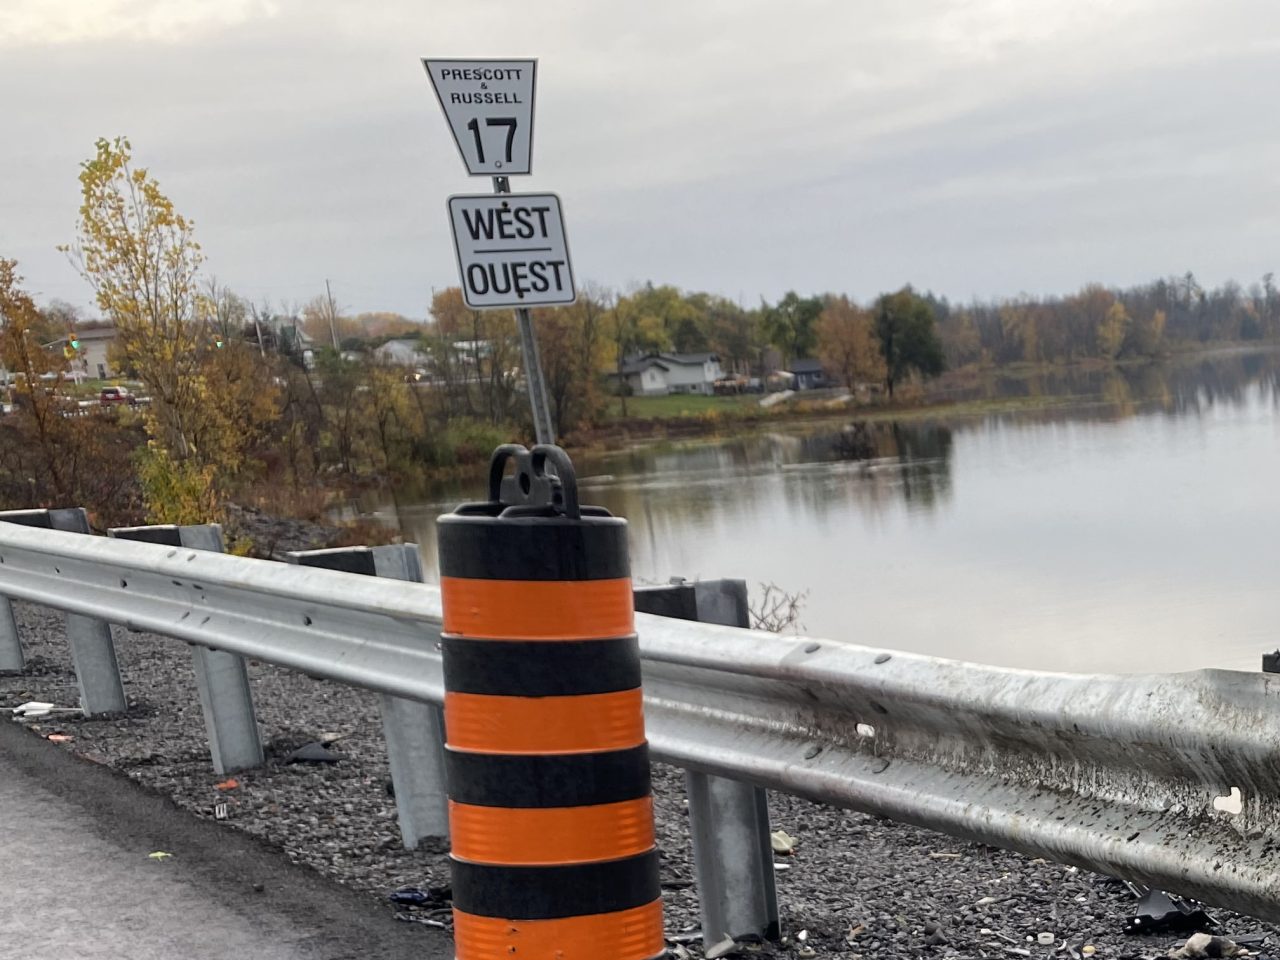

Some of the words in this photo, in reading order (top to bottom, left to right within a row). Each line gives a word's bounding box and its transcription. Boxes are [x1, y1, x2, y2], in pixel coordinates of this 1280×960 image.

[441, 68, 523, 81] PRESCOTT
[480, 82, 488, 90] &
[450, 92, 523, 104] RUSSELL
[467, 117, 518, 164] 17
[462, 206, 550, 240] WEST
[466, 260, 565, 295] OUEST
